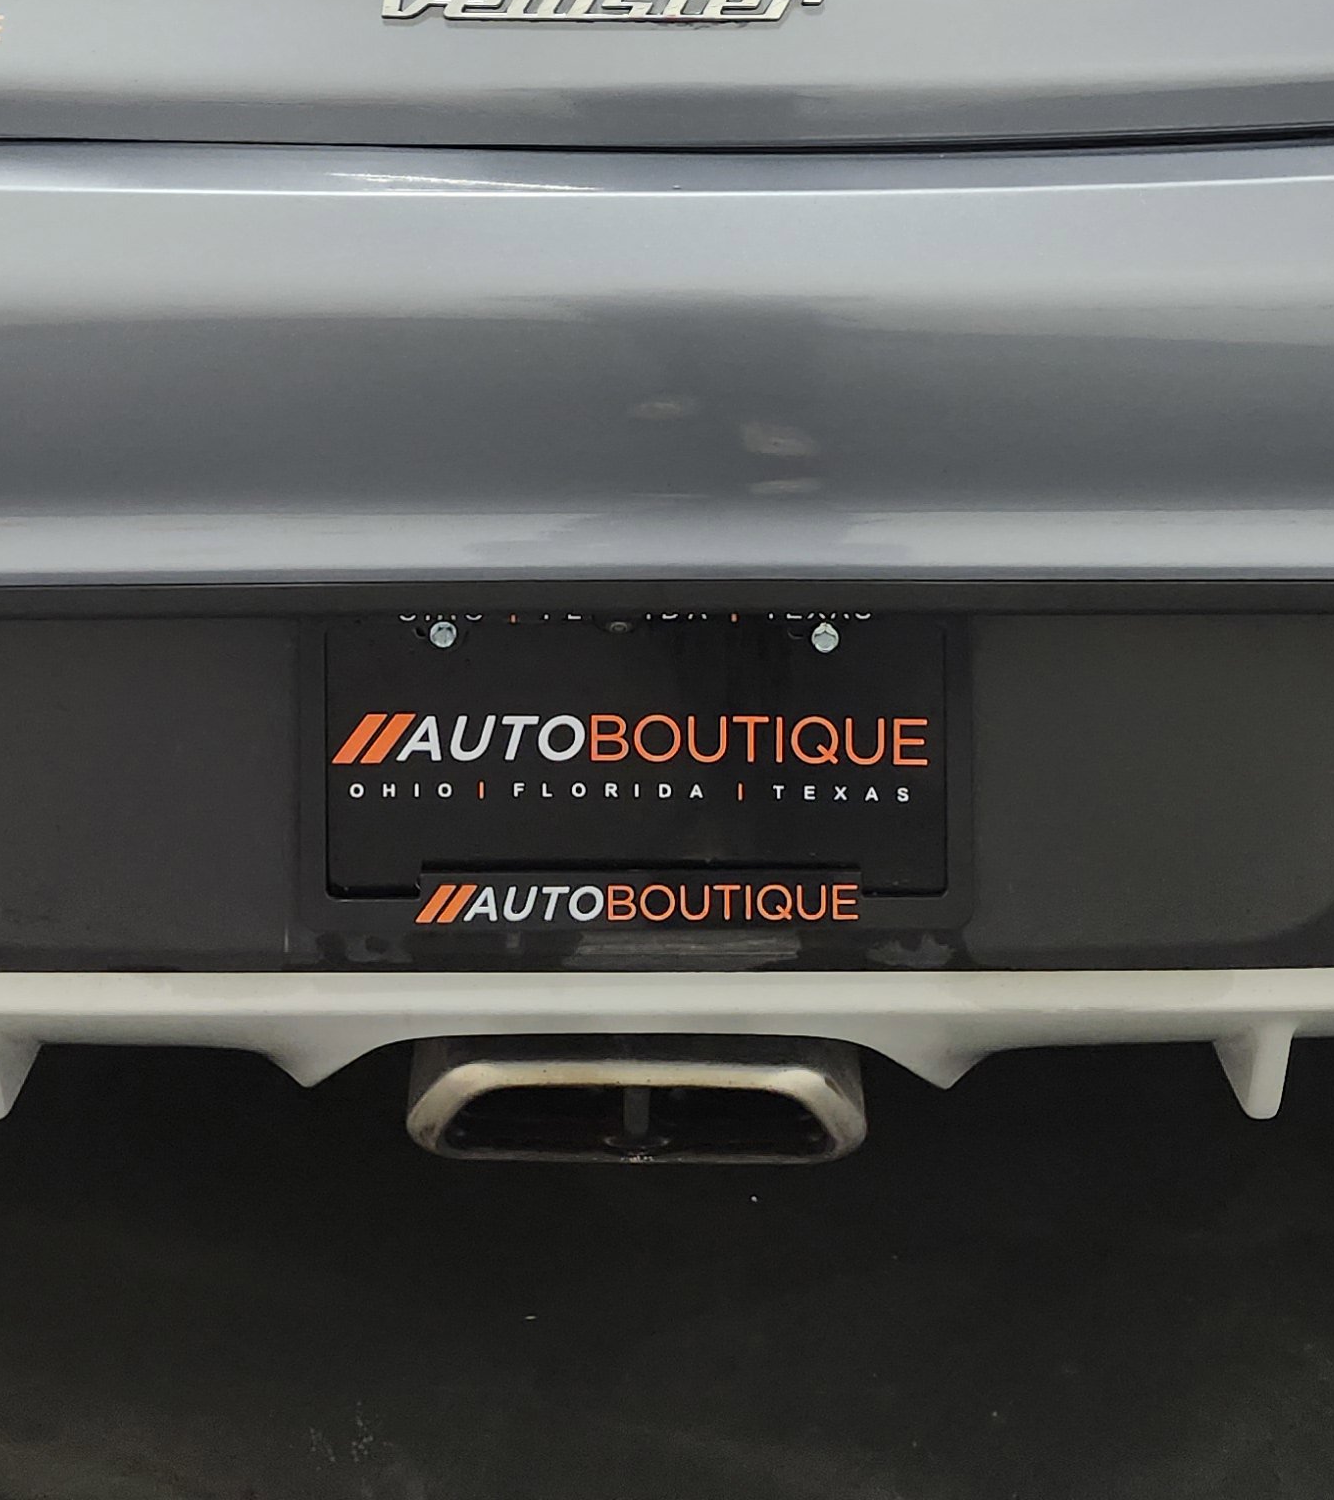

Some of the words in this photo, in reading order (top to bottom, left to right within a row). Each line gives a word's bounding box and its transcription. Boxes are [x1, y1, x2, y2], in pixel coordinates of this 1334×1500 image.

[397, 715, 929, 766] AUTOBOUTIQUE
[349, 784, 452, 799] OHIO
[513, 784, 704, 799] FLORIDA
[773, 785, 910, 803] TEXAS
[465, 885, 858, 922] AUTOBOUTIQUE
